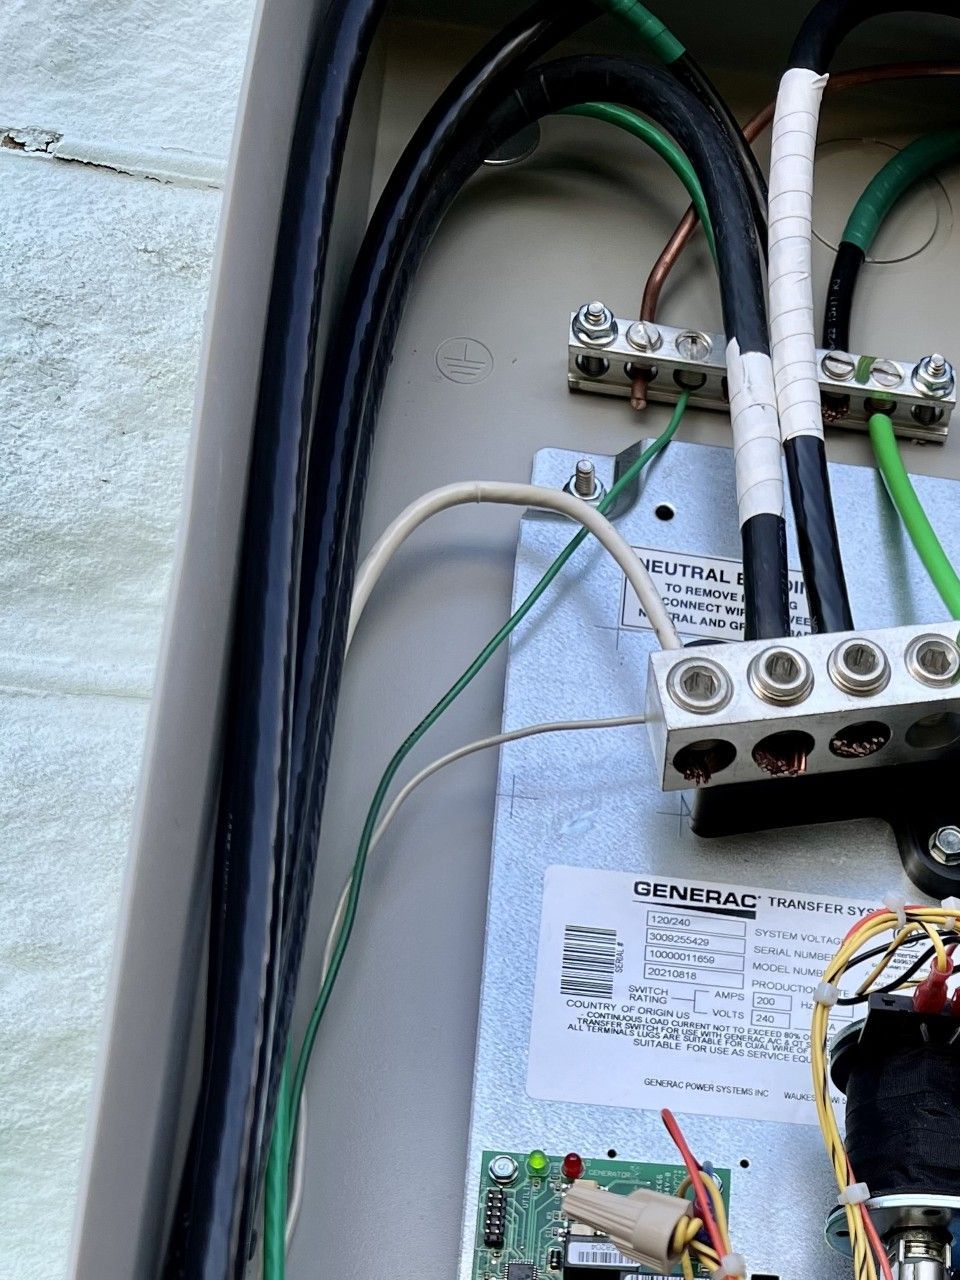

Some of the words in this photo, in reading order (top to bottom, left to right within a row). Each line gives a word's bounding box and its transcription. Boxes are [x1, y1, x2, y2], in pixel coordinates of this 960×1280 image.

[665, 583, 682, 593] TO
[685, 586, 738, 602] REMOVE
[700, 616, 726, 629] AND
[633, 881, 757, 909] GENERAC
[768, 896, 844, 915] TRANSFER
[652, 915, 691, 927] 120/240
[649, 932, 710, 947] 3009255429
[755, 928, 798, 940] SYSTEM
[754, 946, 791, 957] SERIAL
[614, 948, 625, 974] SERIAL
[752, 962, 790, 974] MODEL
[648, 967, 697, 981] 20210818
[628, 985, 669, 996] SWITCH
[629, 994, 667, 1005] RATING
[714, 991, 745, 1001] AMPS
[756, 996, 776, 1006] 200
[801, 1001, 813, 1010] Hz
[566, 999, 617, 1012] COUNTRY
[621, 1005, 636, 1013] OF
[637, 1006, 674, 1018] ORIGIN
[676, 1011, 691, 1019] US
[712, 1008, 745, 1020] VOLTS
[755, 1014, 775, 1024] 240
[577, 1018, 622, 1029] TRANSFER
[625, 1022, 659, 1032] SWITCH
[661, 1026, 679, 1035] FOR
[682, 1028, 698, 1037] USE
[700, 1030, 722, 1039] WITH
[724, 1032, 766, 1044] GENERAC
[586, 1011, 643, 1024] CONTINUOUS
[645, 1017, 669, 1026] LOAD
[671, 1020, 711, 1031] CURRENT
[713, 1024, 730, 1033] NOT
[733, 1026, 745, 1034] TO
[747, 1028, 782, 1038] EXCEED
[784, 1031, 801, 1040] 80%
[567, 1023, 583, 1032] ALL
[587, 1025, 635, 1037] TERMINALS
[637, 1030, 660, 1040] LUGS
[663, 1033, 681, 1042] ARE
[683, 1036, 722, 1046] SUITABLE
[725, 1040, 743, 1048] FOR
[772, 1045, 795, 1054] WIRE
[633, 1039, 682, 1050] SUITABLE
[687, 1044, 707, 1053] FOR
[709, 1046, 730, 1056] USE
[731, 1049, 745, 1057] AS
[747, 1050, 790, 1062] SERVICE
[644, 1078, 684, 1090] GENERAC
[685, 1082, 715, 1092] POWER
[716, 1085, 753, 1097] SYSTEMS
[755, 1089, 770, 1097] INC
